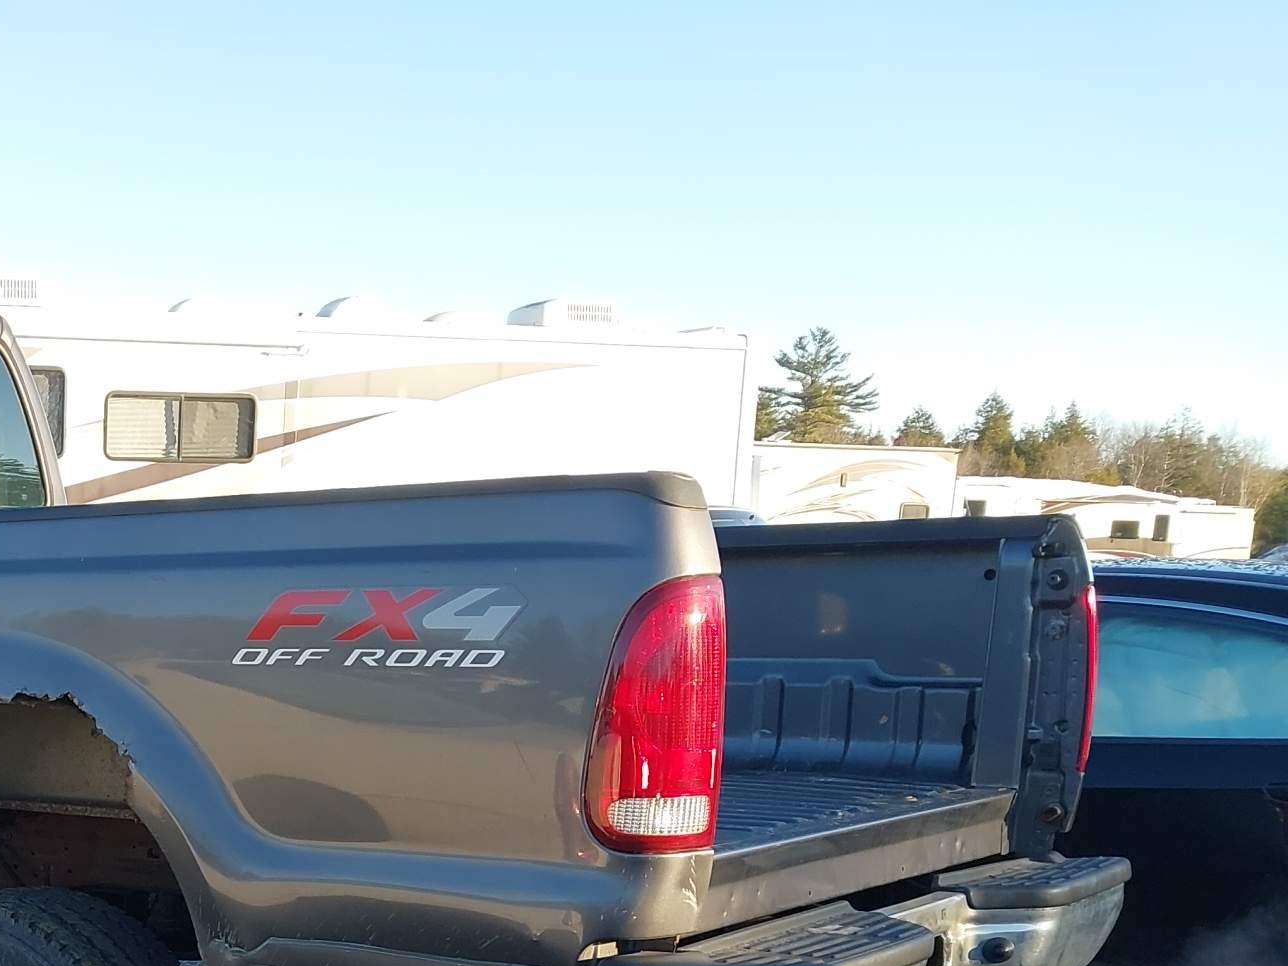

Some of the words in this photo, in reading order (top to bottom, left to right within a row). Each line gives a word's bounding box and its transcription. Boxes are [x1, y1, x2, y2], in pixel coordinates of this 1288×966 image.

[246, 587, 522, 641] FX4
[231, 648, 331, 666] OFF
[343, 648, 505, 668] ROAD
